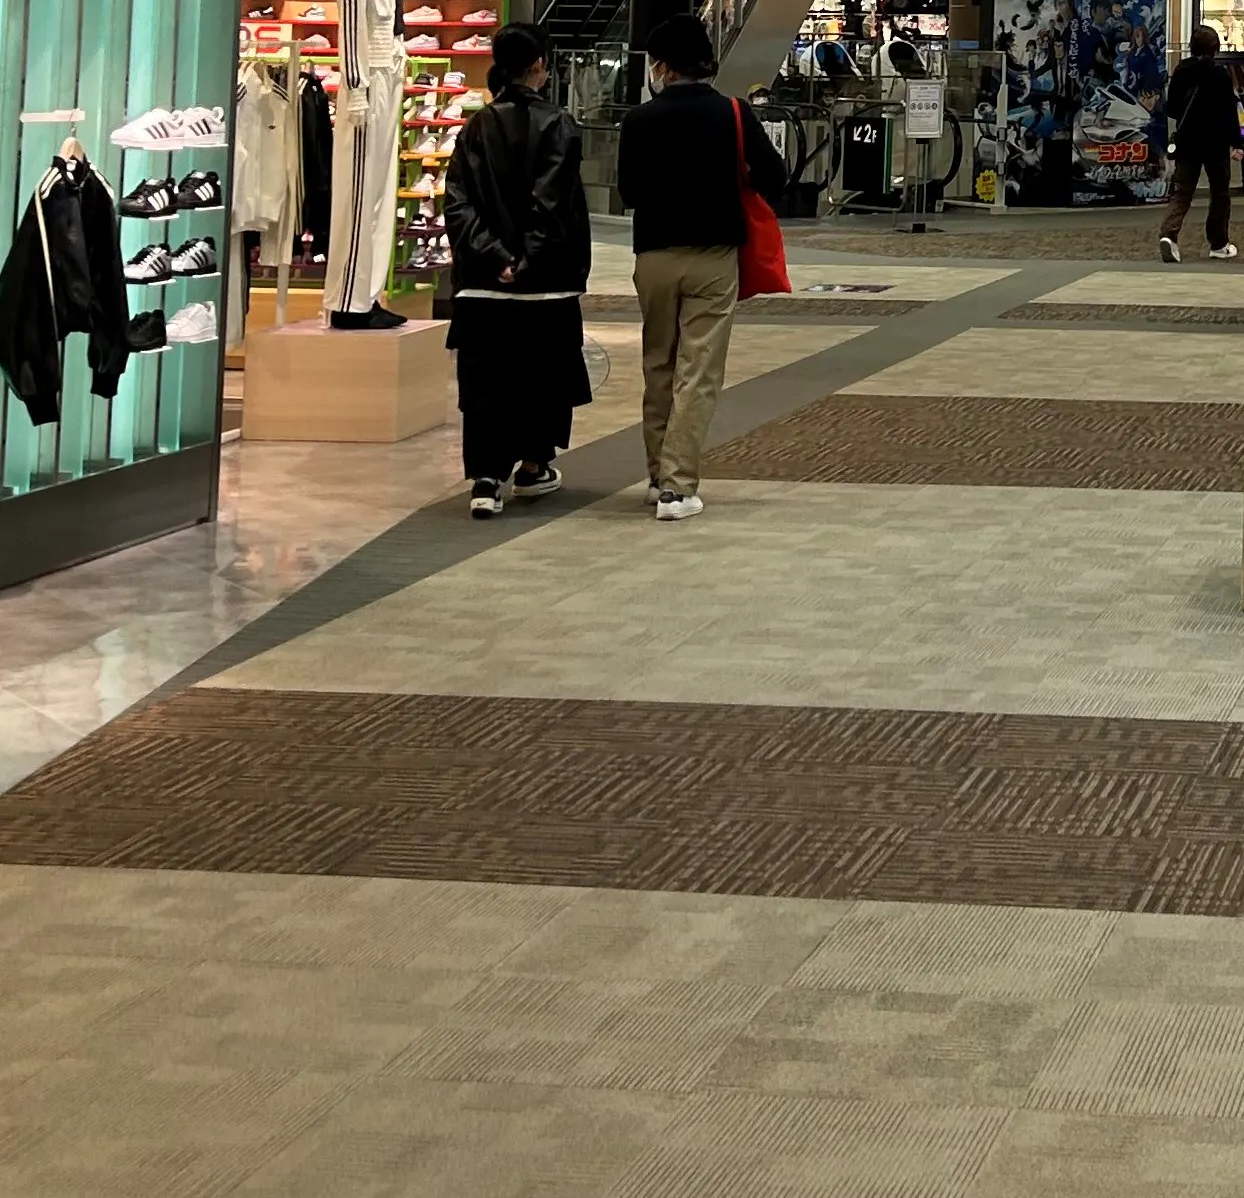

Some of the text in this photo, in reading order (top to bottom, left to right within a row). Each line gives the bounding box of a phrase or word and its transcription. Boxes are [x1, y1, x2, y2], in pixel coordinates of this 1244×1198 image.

[863, 123, 877, 144] 2F
[1098, 141, 1149, 163] コナン
